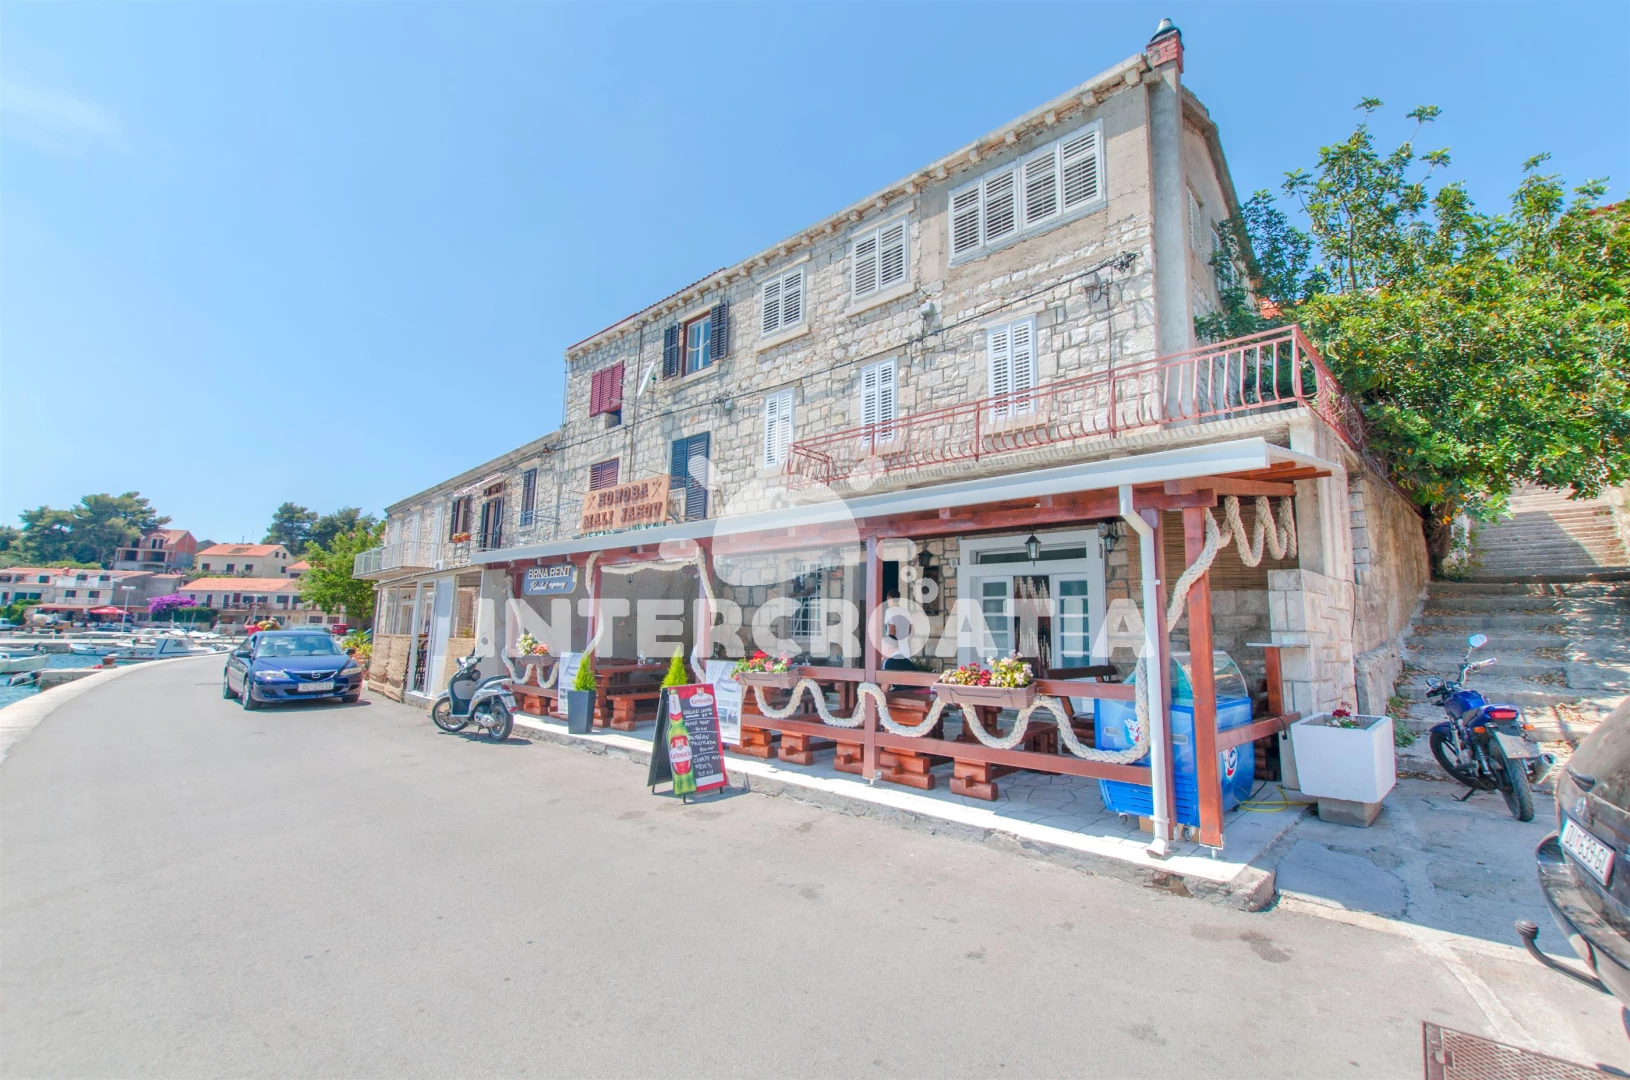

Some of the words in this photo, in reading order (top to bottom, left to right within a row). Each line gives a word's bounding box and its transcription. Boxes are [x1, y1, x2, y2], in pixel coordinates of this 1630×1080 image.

[598, 483, 648, 508] KONOBA
[583, 510, 614, 529] MALI
[621, 501, 663, 523] JAKOV
[528, 568, 549, 579] BRNA
[550, 566, 572, 578] RENT
